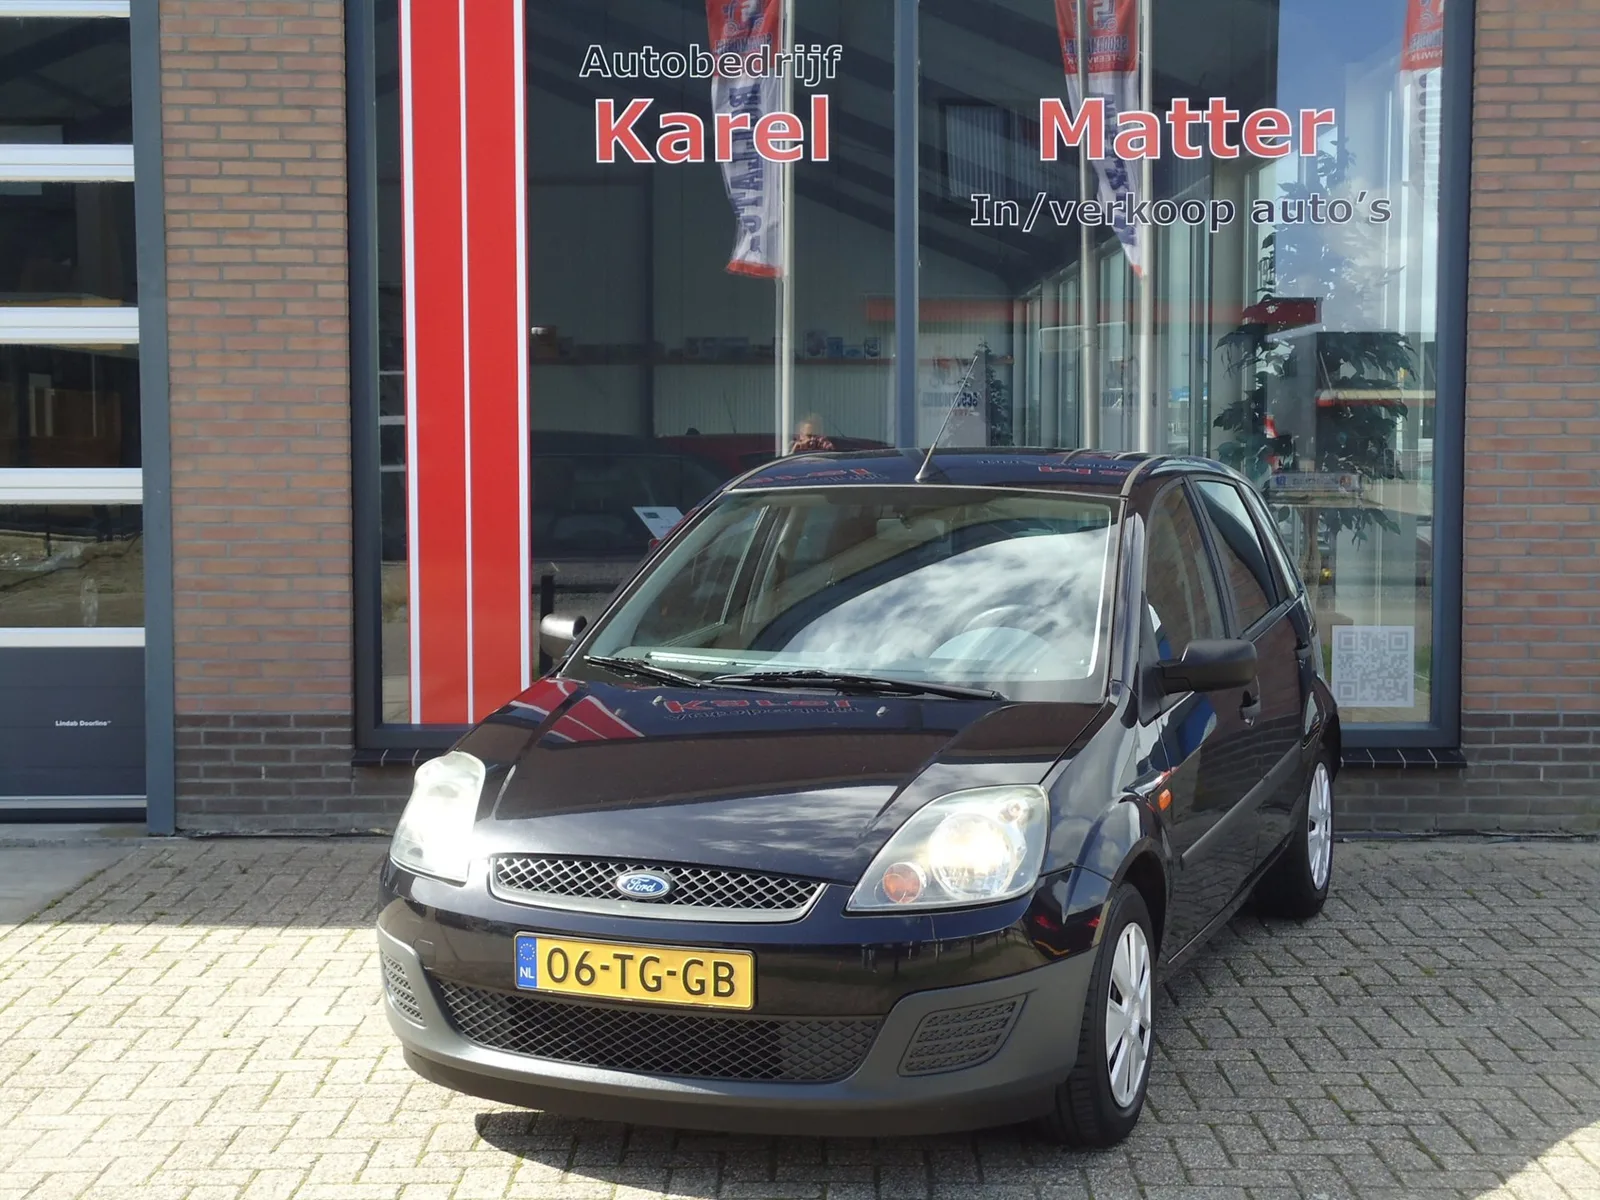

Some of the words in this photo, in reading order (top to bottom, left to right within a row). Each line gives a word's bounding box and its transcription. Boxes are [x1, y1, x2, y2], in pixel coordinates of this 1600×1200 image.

[579, 44, 843, 86] Autobedrijf
[595, 94, 831, 164] Karel
[1039, 97, 1336, 162] Matter
[970, 191, 1236, 233] In/verkoop
[1251, 191, 1393, 225] auto's
[626, 877, 656, 893] Ford
[519, 967, 535, 979] NL
[546, 947, 736, 998] 06-TG-GB
